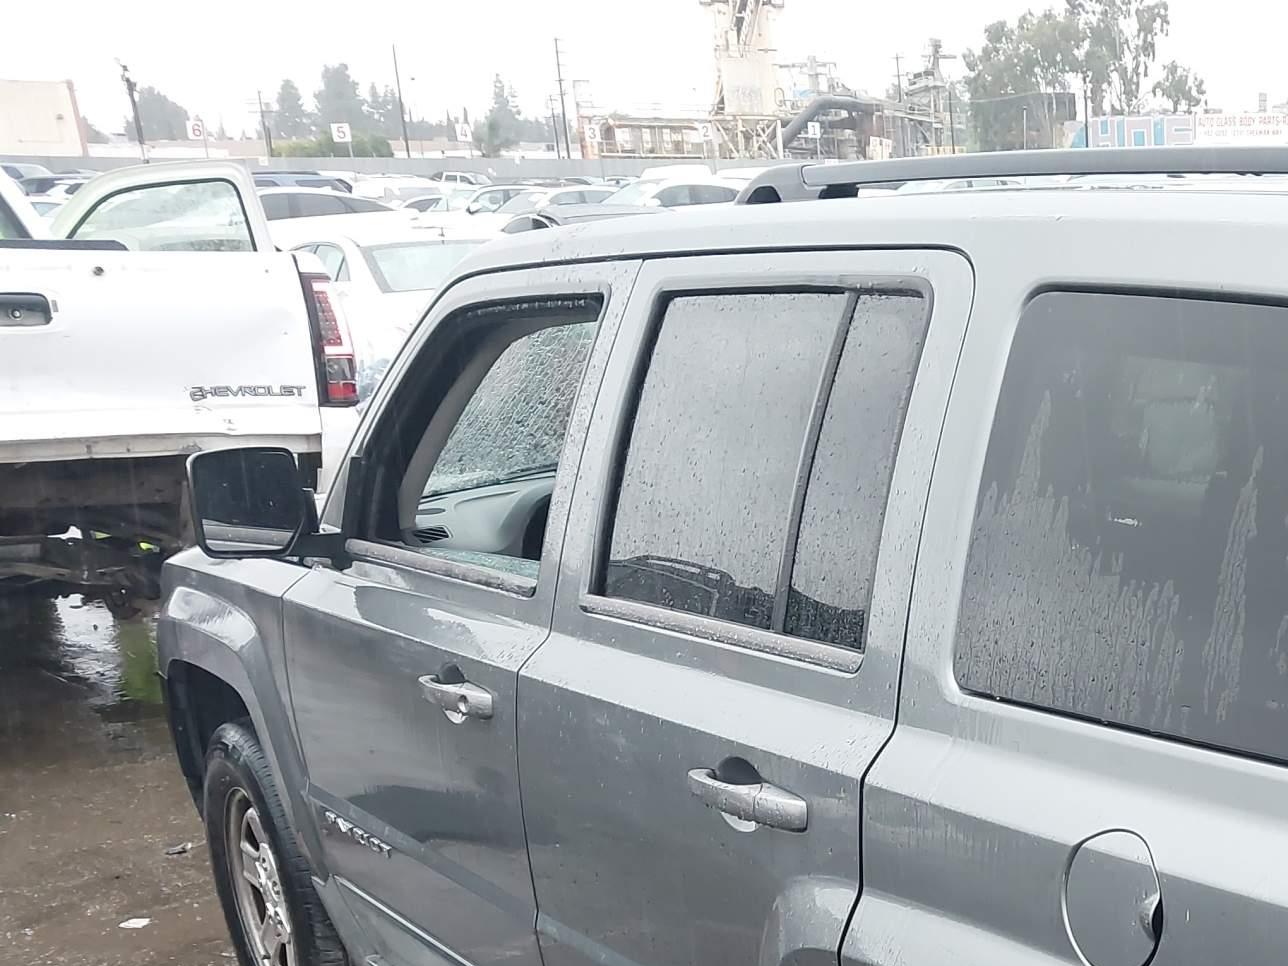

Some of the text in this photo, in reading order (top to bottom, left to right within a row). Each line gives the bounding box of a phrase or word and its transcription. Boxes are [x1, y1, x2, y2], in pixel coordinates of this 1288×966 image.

[1216, 114, 1237, 127] GLASS
[1239, 114, 1256, 127] BODY
[191, 123, 202, 138] 6
[336, 125, 346, 139] 5
[460, 126, 468, 139] 4
[588, 126, 596, 140] 3
[702, 124, 711, 138] 2
[810, 124, 818, 136] 1
[189, 385, 306, 402] CHEVROLET
